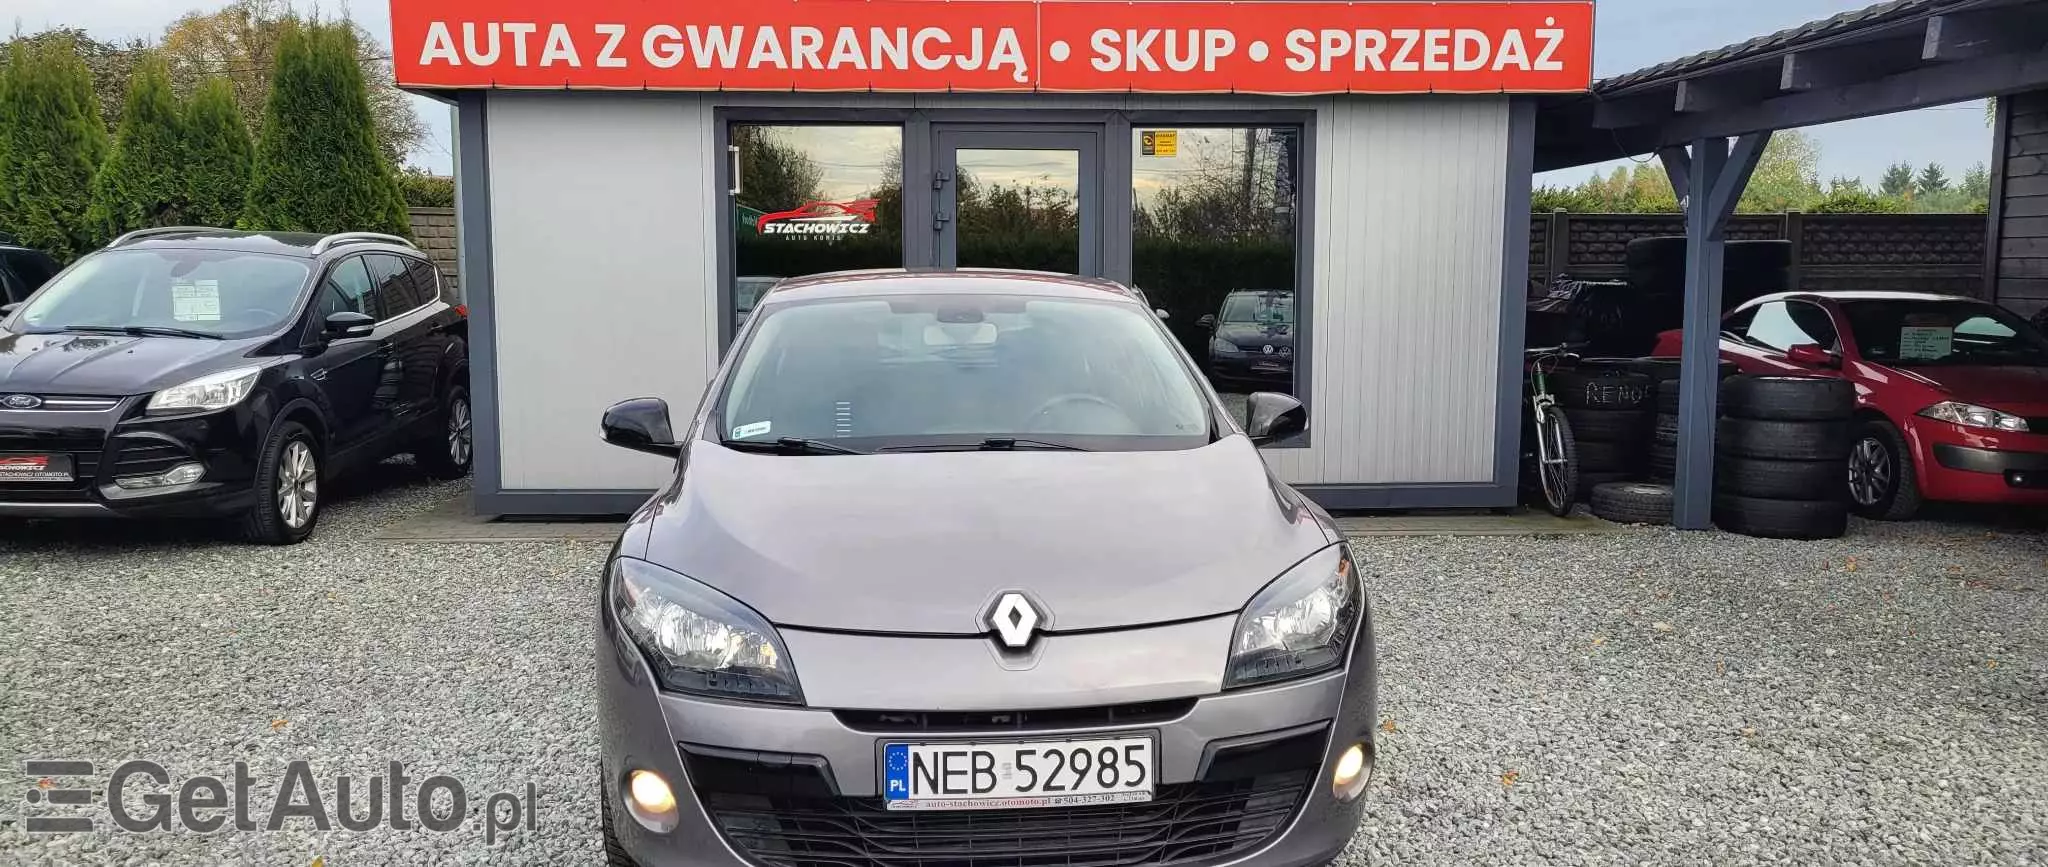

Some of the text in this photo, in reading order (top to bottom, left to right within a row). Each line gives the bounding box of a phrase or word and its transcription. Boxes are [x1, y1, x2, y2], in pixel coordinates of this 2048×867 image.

[419, 16, 1565, 83] AUTA Z GWARANCJĄ SKUP SPRZEDAŻ
[764, 223, 871, 234] STACHOWICZ
[890, 744, 1146, 795] PL NEB 52985
